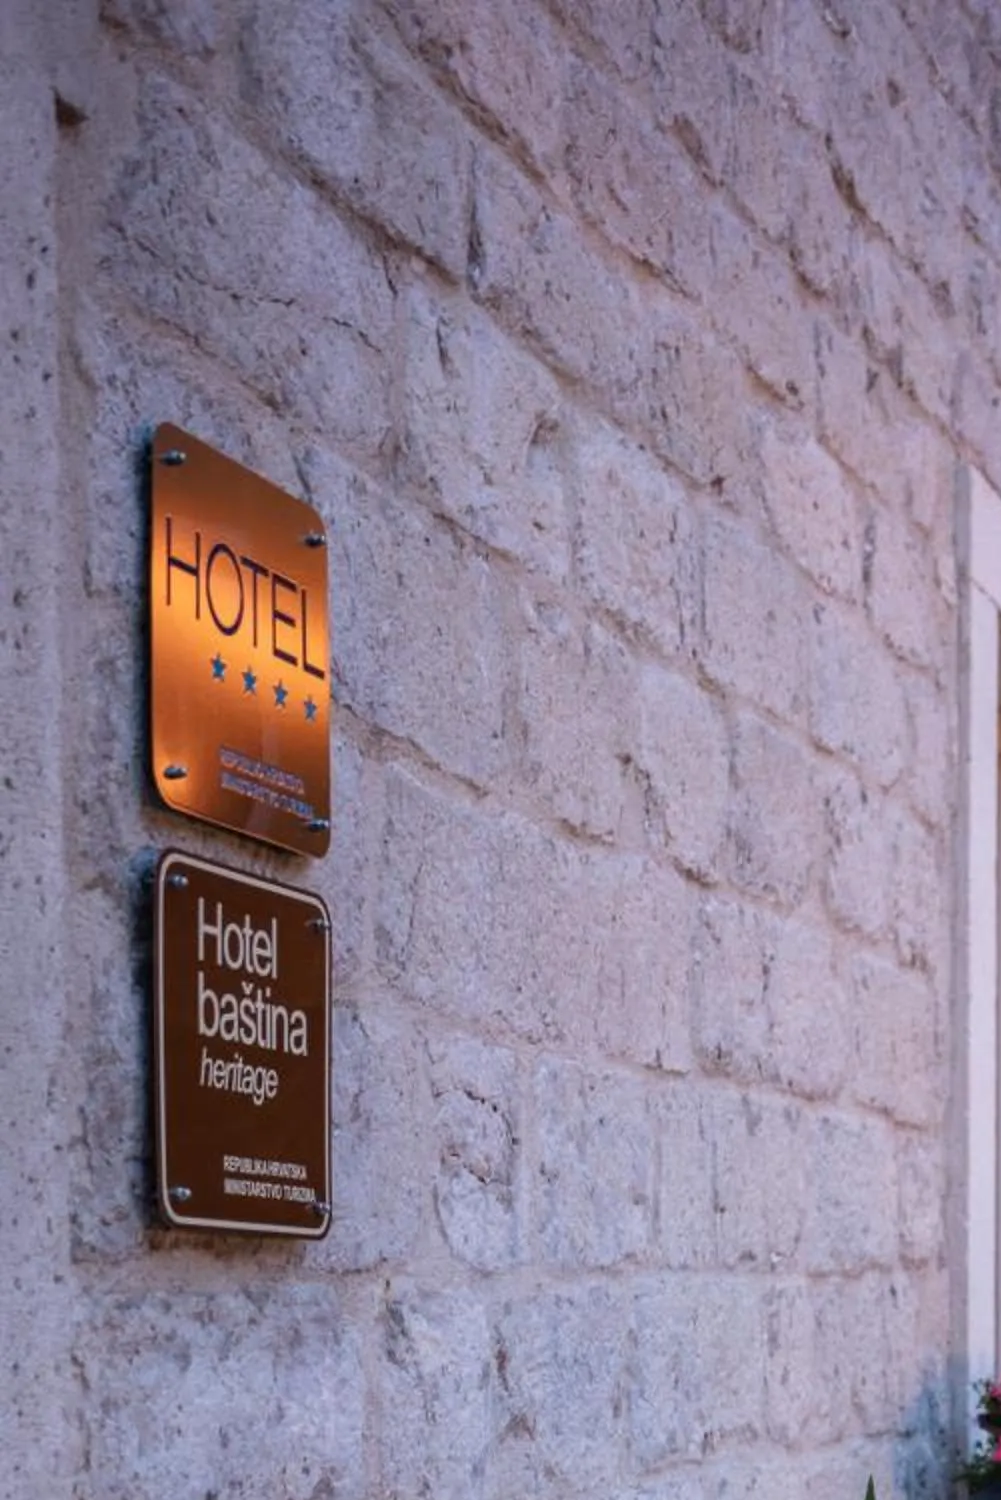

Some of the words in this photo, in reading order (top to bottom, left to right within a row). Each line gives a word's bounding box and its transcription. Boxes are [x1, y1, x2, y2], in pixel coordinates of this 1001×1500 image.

[165, 516, 325, 680] HOTEL
[198, 896, 278, 979] Hotel
[197, 970, 308, 1057] baština
[200, 1046, 279, 1106] heritage
